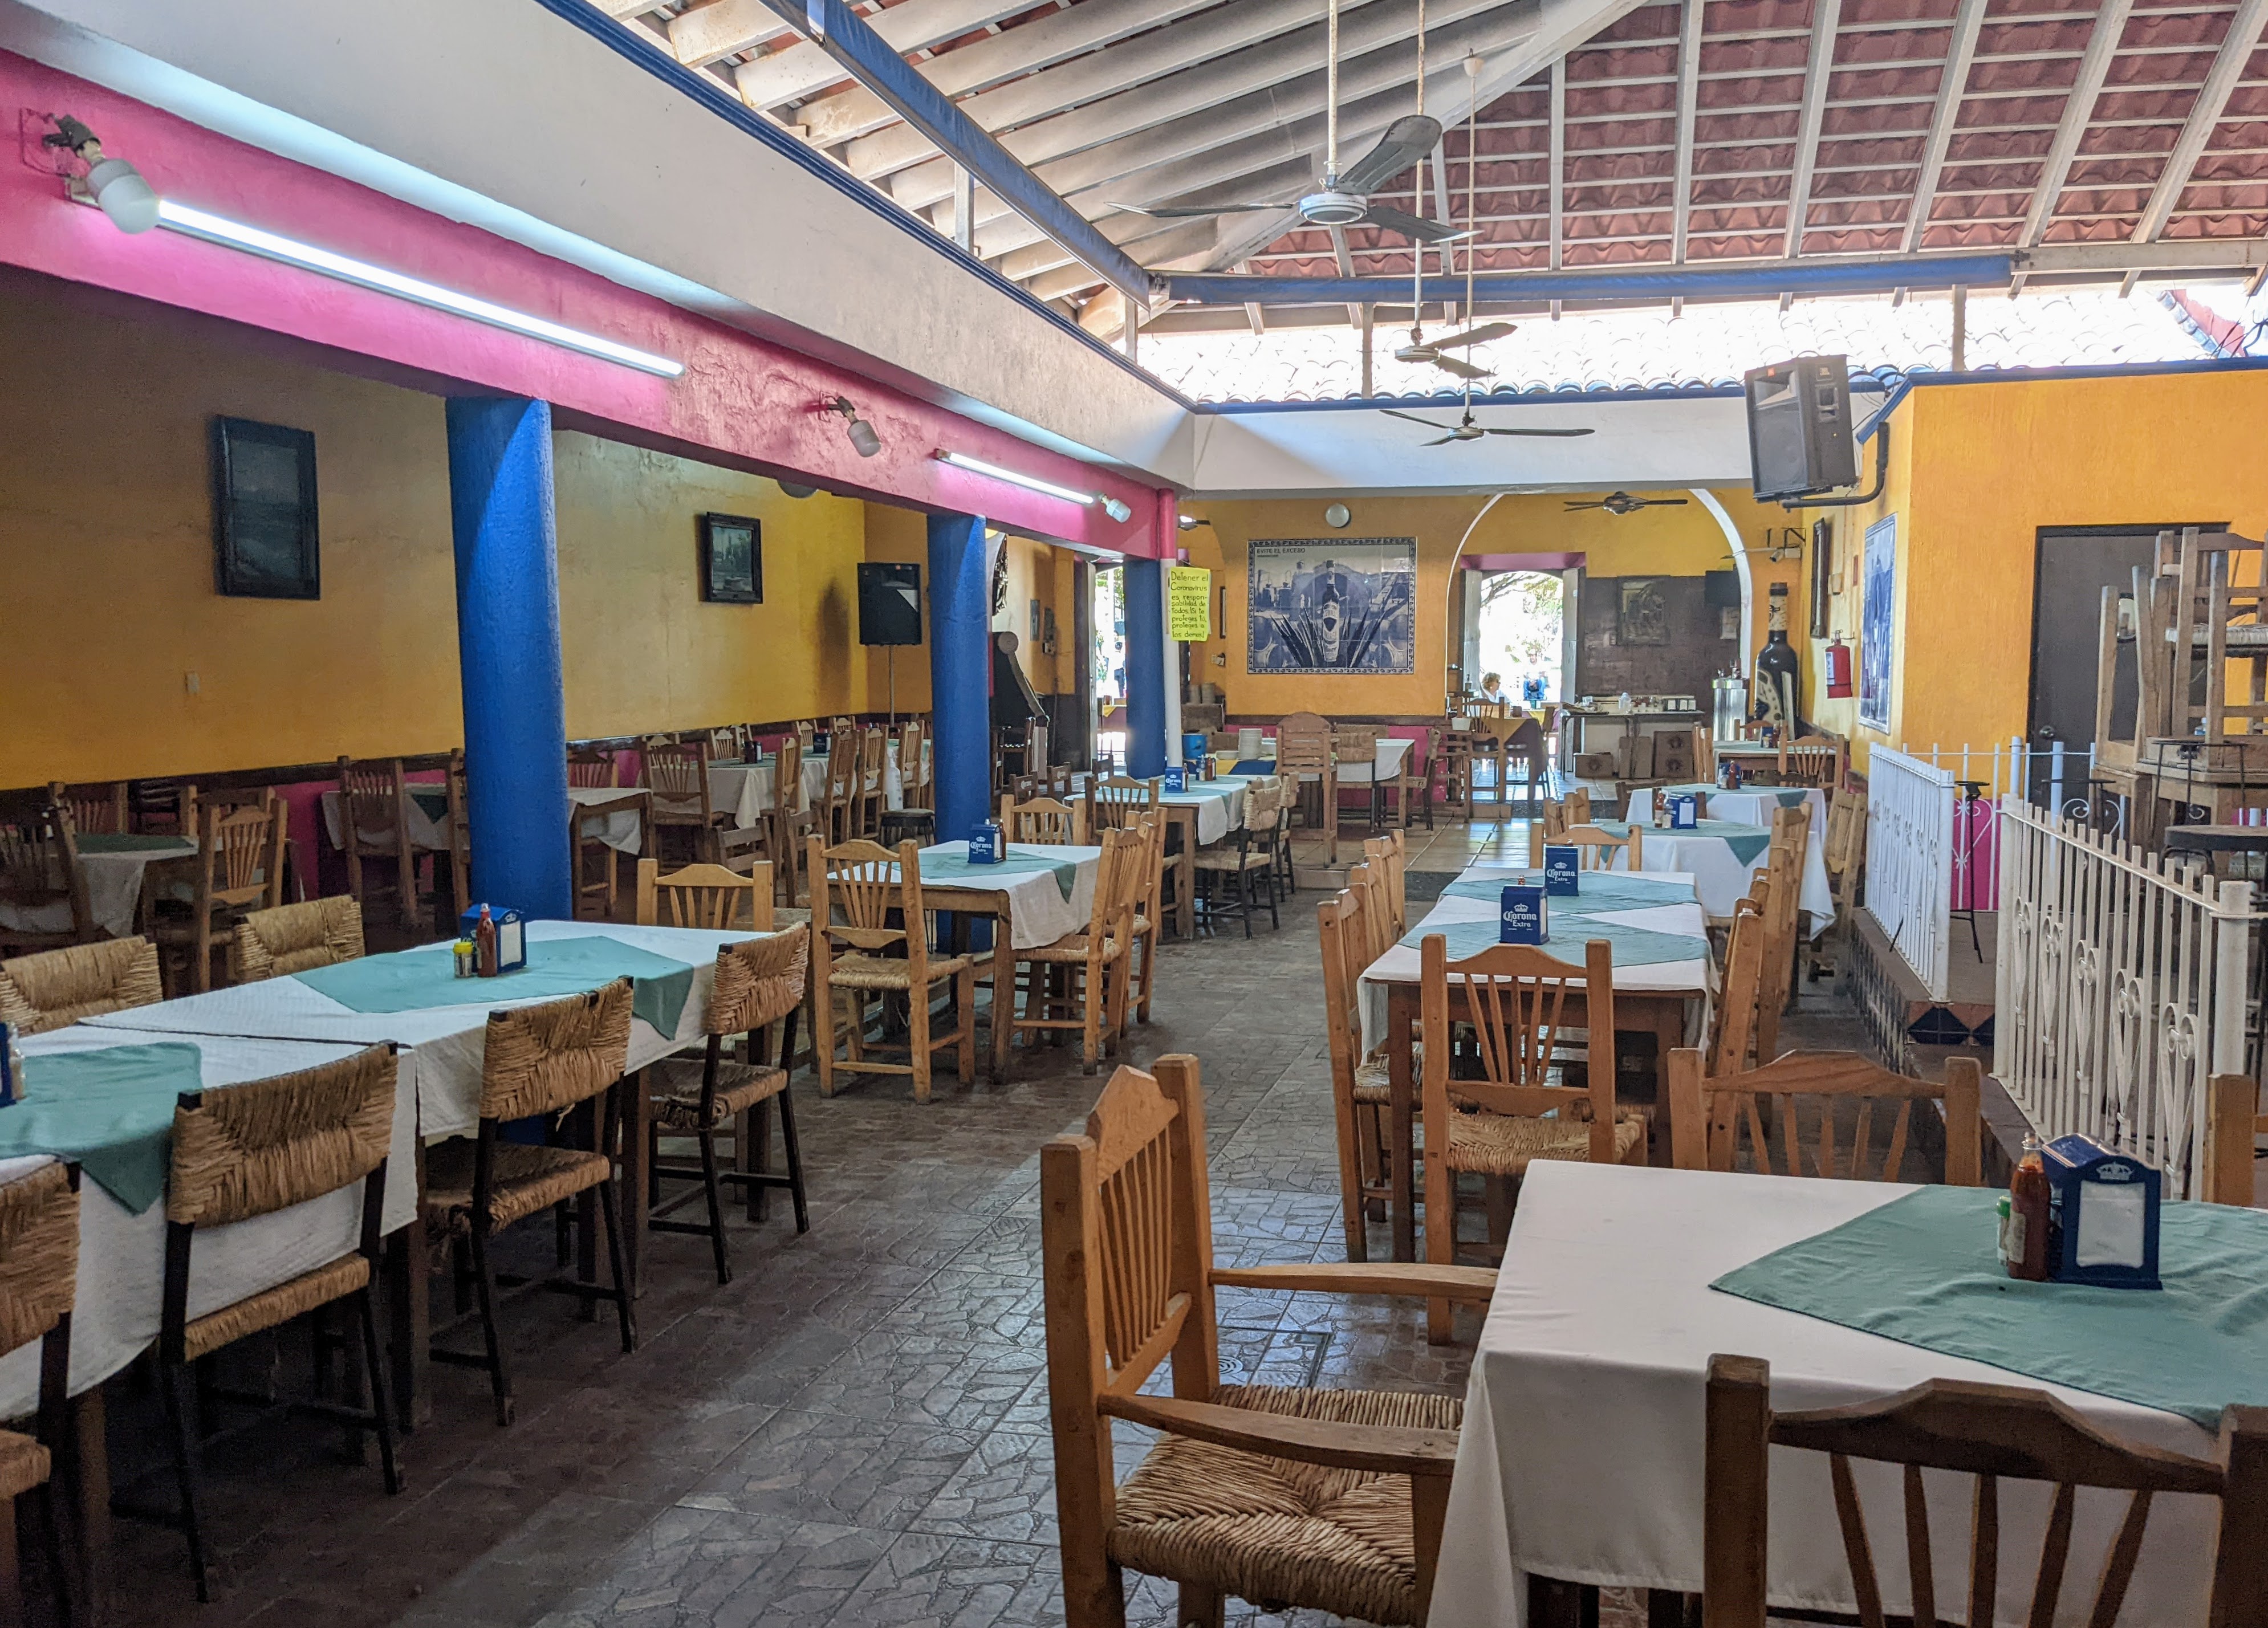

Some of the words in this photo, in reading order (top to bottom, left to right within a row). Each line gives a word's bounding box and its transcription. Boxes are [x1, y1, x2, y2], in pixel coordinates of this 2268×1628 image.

[1171, 571, 1200, 581] Detener
[1170, 581, 1208, 592] Coronavirus
[1172, 614, 1197, 623] proteges
[1172, 621, 1198, 630] proteges
[1546, 868, 1575, 878] Corona
[1503, 910, 1537, 922] Corona
